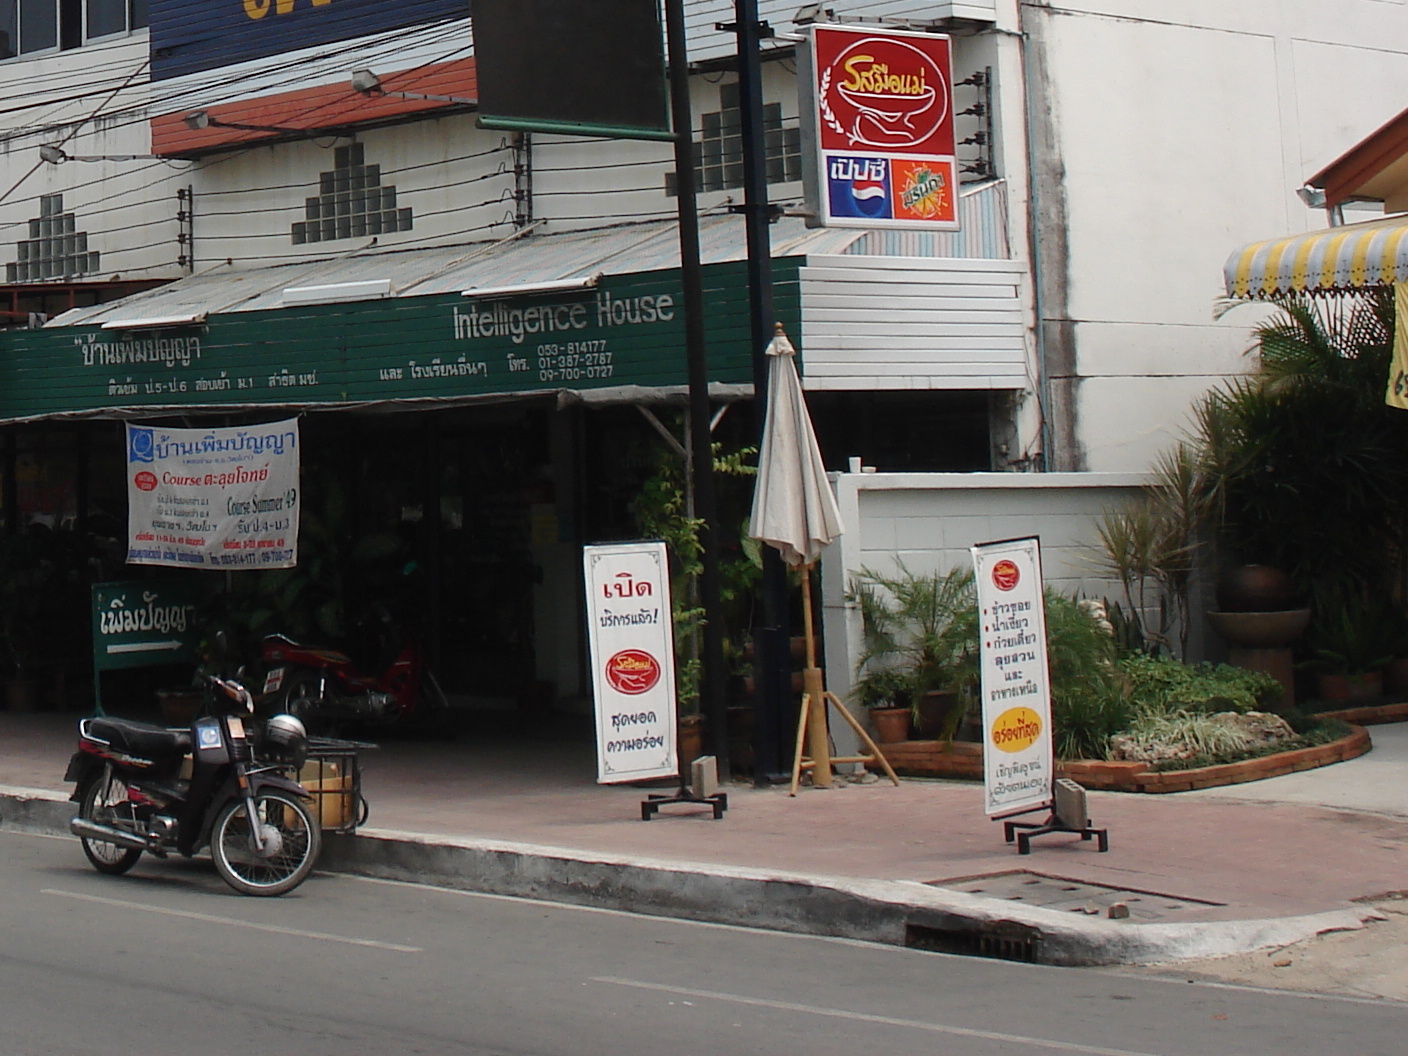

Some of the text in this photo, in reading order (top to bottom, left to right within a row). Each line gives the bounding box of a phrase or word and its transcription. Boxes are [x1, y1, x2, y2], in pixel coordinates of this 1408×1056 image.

[453, 291, 674, 343] Intelligence House
[380, 367, 403, 381] และ
[507, 353, 530, 372] โทร.
[537, 340, 607, 357] 053-814177
[538, 352, 613, 369] 01-387-2787
[539, 366, 613, 382] 09-700-0727
[156, 431, 295, 460] บ้านเพิ่มปัญญา
[163, 472, 201, 486] Course
[227, 496, 250, 516] Course
[603, 572, 652, 599] เปิด
[1004, 670, 1023, 682] และ
[610, 710, 657, 734] สุดยอด
[993, 711, 1040, 744] อร่อยที่สุด
[606, 730, 665, 753] ความอร่อย
